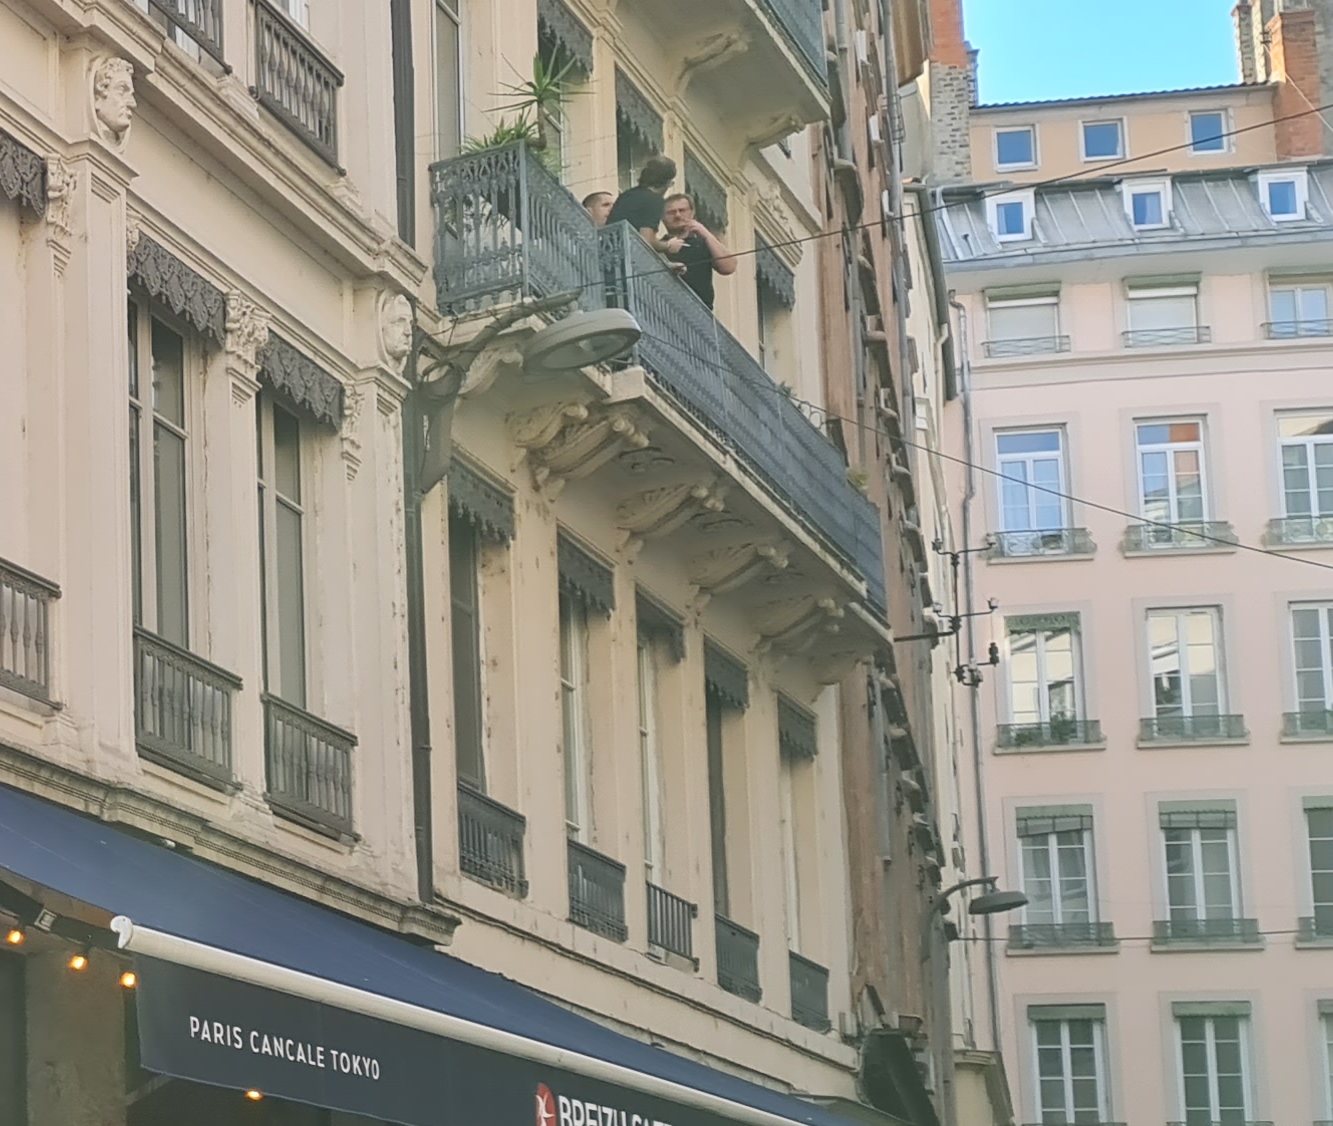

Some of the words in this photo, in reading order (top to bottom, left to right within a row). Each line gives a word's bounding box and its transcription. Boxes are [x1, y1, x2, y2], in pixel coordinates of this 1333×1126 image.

[189, 1016, 243, 1050] PARIS
[249, 1031, 325, 1068] CANCALE
[330, 1050, 380, 1081] TOKYO
